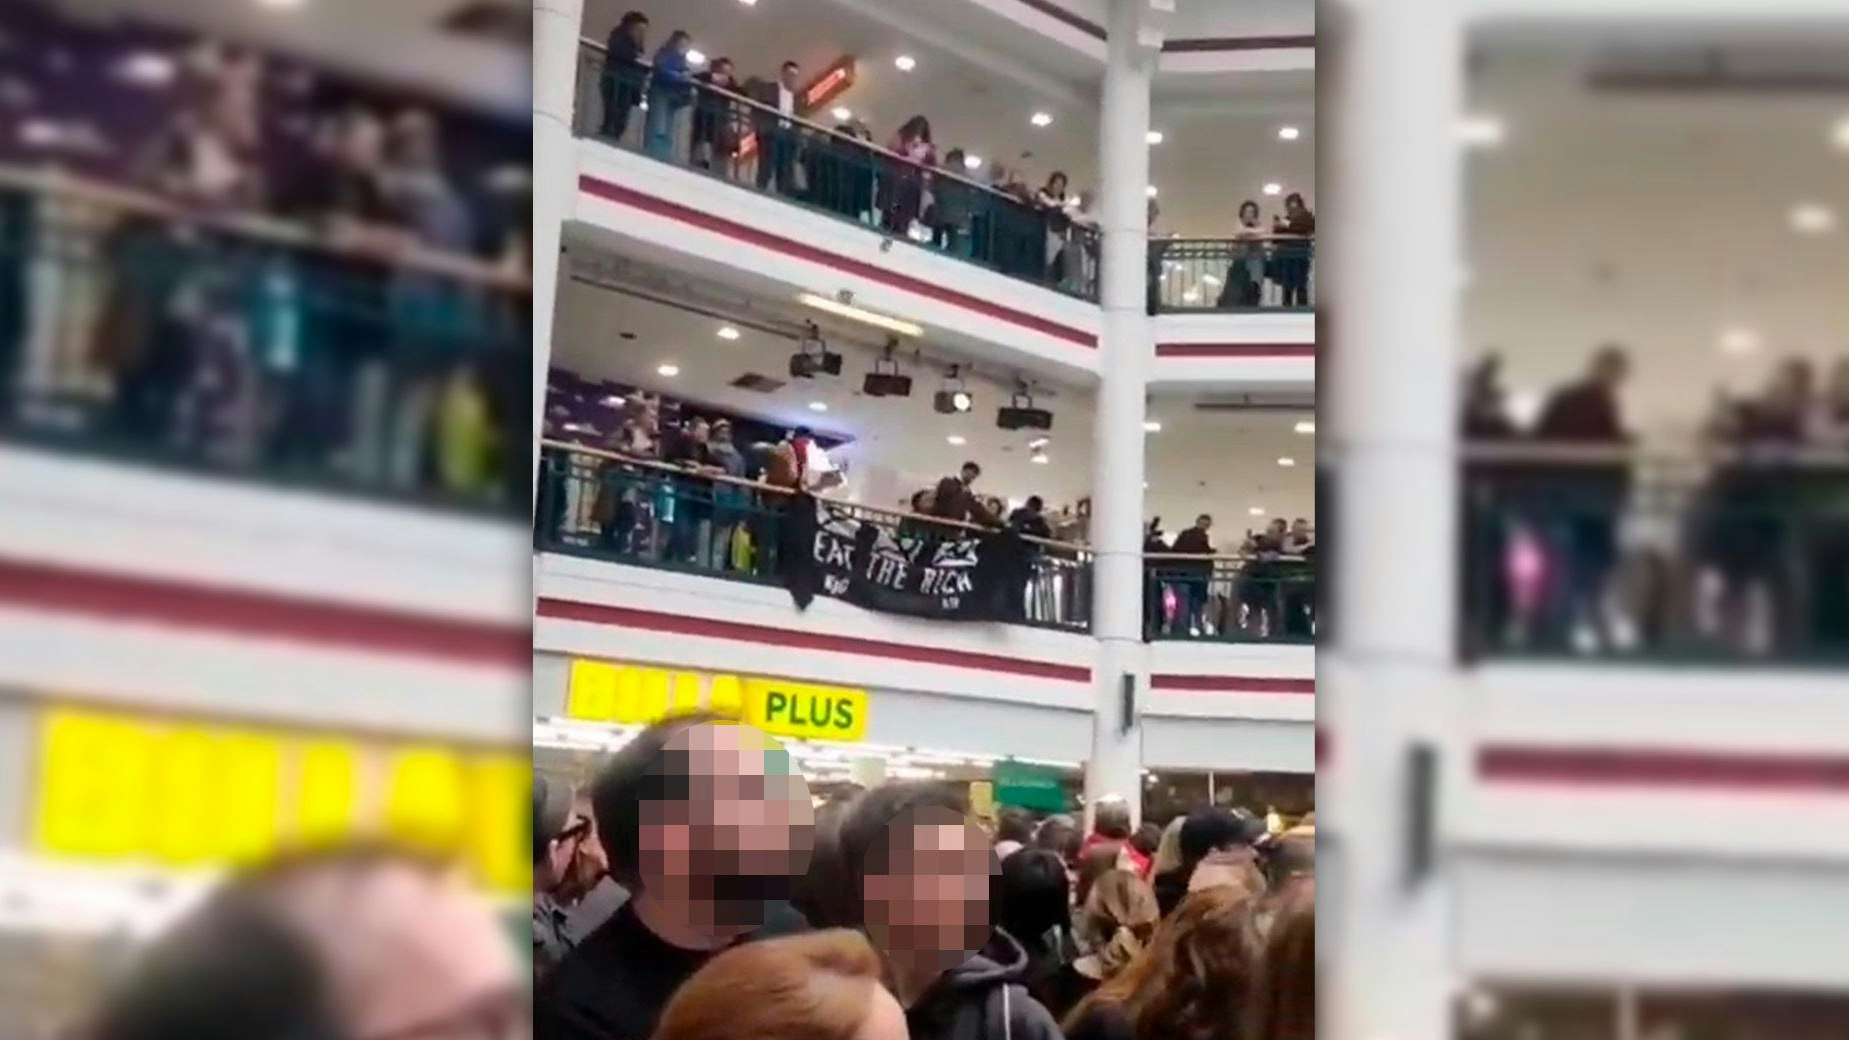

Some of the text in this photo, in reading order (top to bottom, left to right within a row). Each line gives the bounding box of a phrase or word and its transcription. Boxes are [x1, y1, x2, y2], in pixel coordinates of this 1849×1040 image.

[814, 531, 972, 594] EAT THE RICH
[767, 692, 853, 729] PLUS
